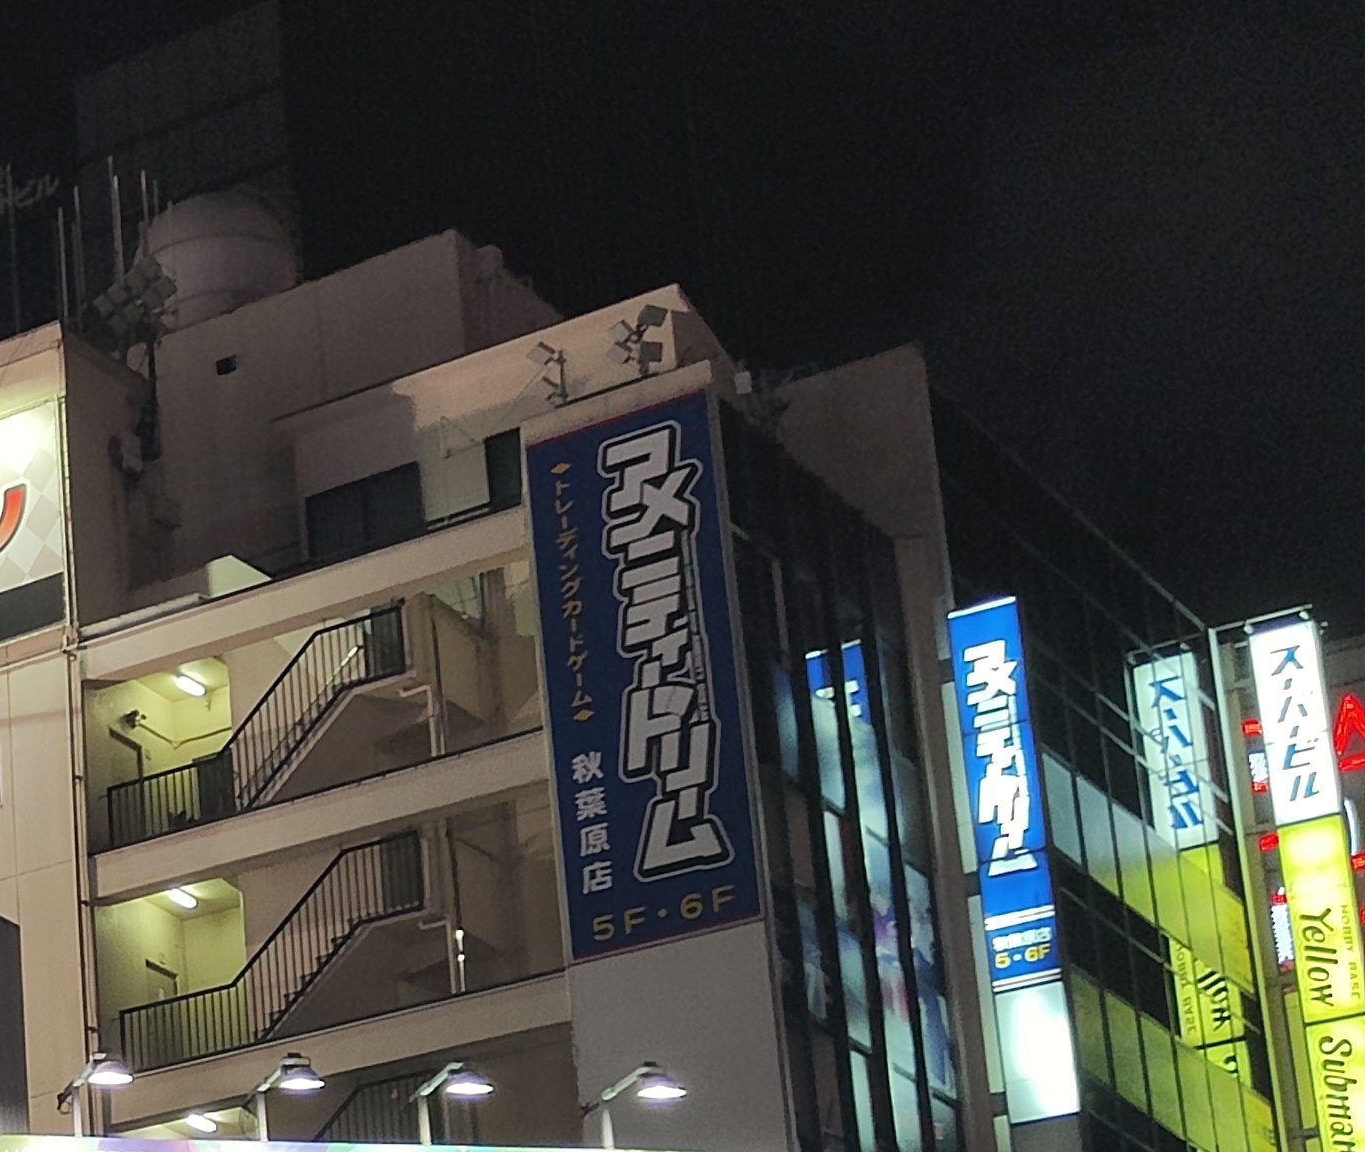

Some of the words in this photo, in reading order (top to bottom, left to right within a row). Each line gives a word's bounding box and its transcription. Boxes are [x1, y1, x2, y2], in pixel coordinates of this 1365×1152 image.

[555, 479, 593, 708] トレーディングカードゲーム
[1269, 645, 1320, 802] スーパービル
[571, 750, 613, 896] 秋葉原店
[1298, 906, 1333, 1009] Yellow
